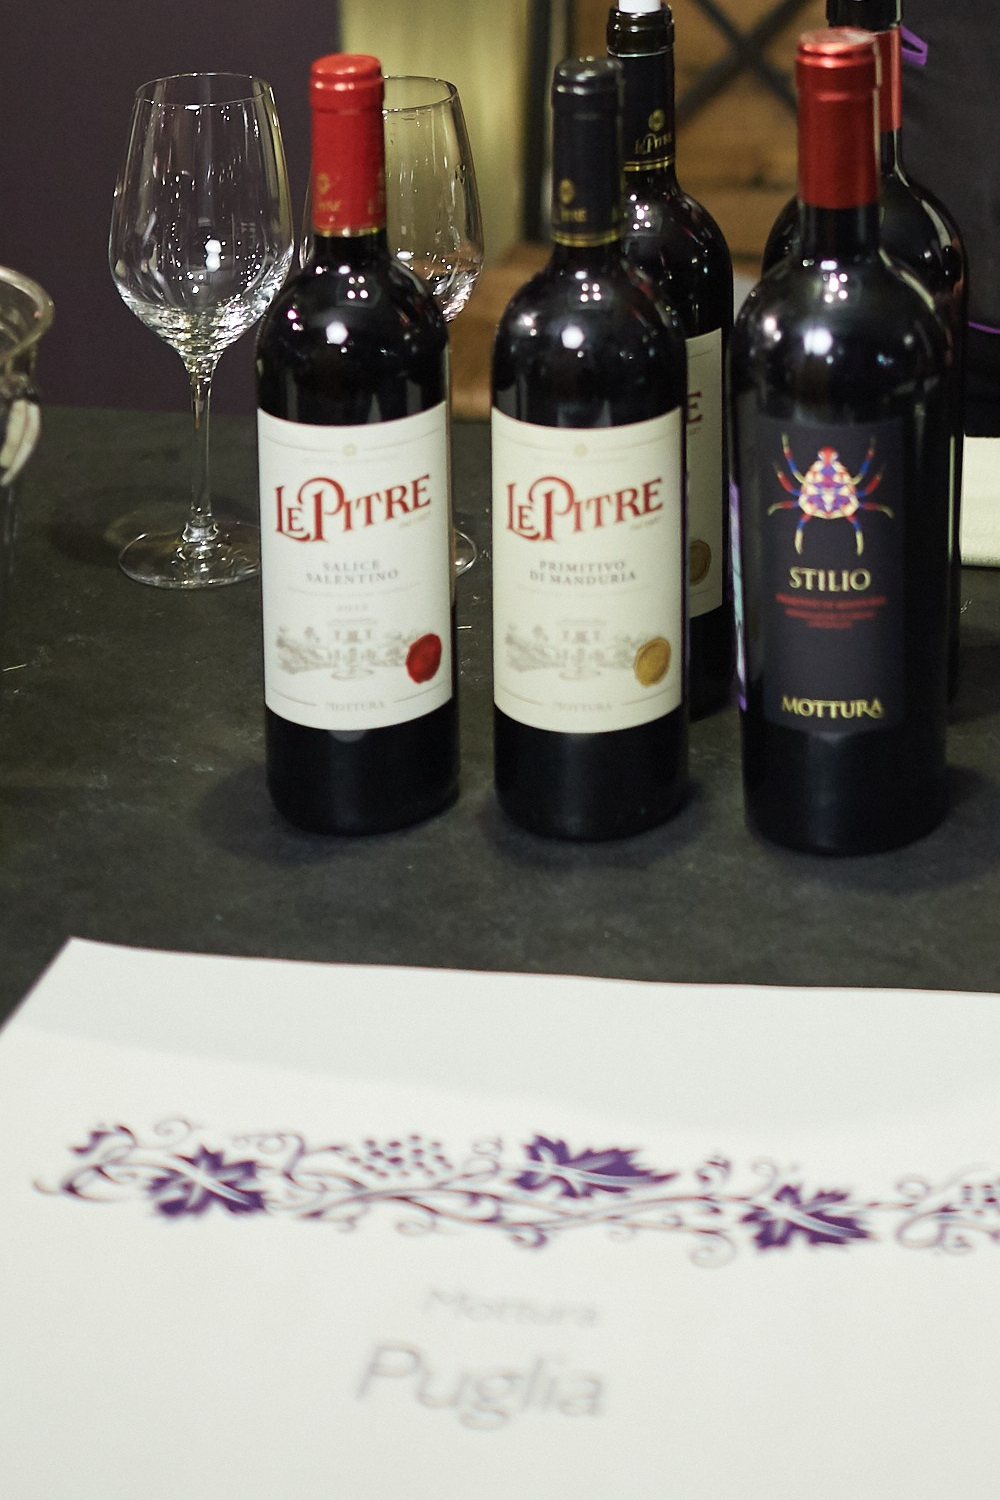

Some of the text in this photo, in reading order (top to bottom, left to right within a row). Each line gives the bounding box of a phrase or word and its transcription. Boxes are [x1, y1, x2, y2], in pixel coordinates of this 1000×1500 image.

[322, 560, 381, 573] SALICE
[539, 560, 626, 573] PRIMITIVO
[305, 568, 399, 585] SALENTINO
[529, 570, 637, 586] DI MANDURIA
[789, 566, 871, 591] STILIO
[782, 695, 885, 719] MOTTURA
[355, 1340, 605, 1431] Puglia
